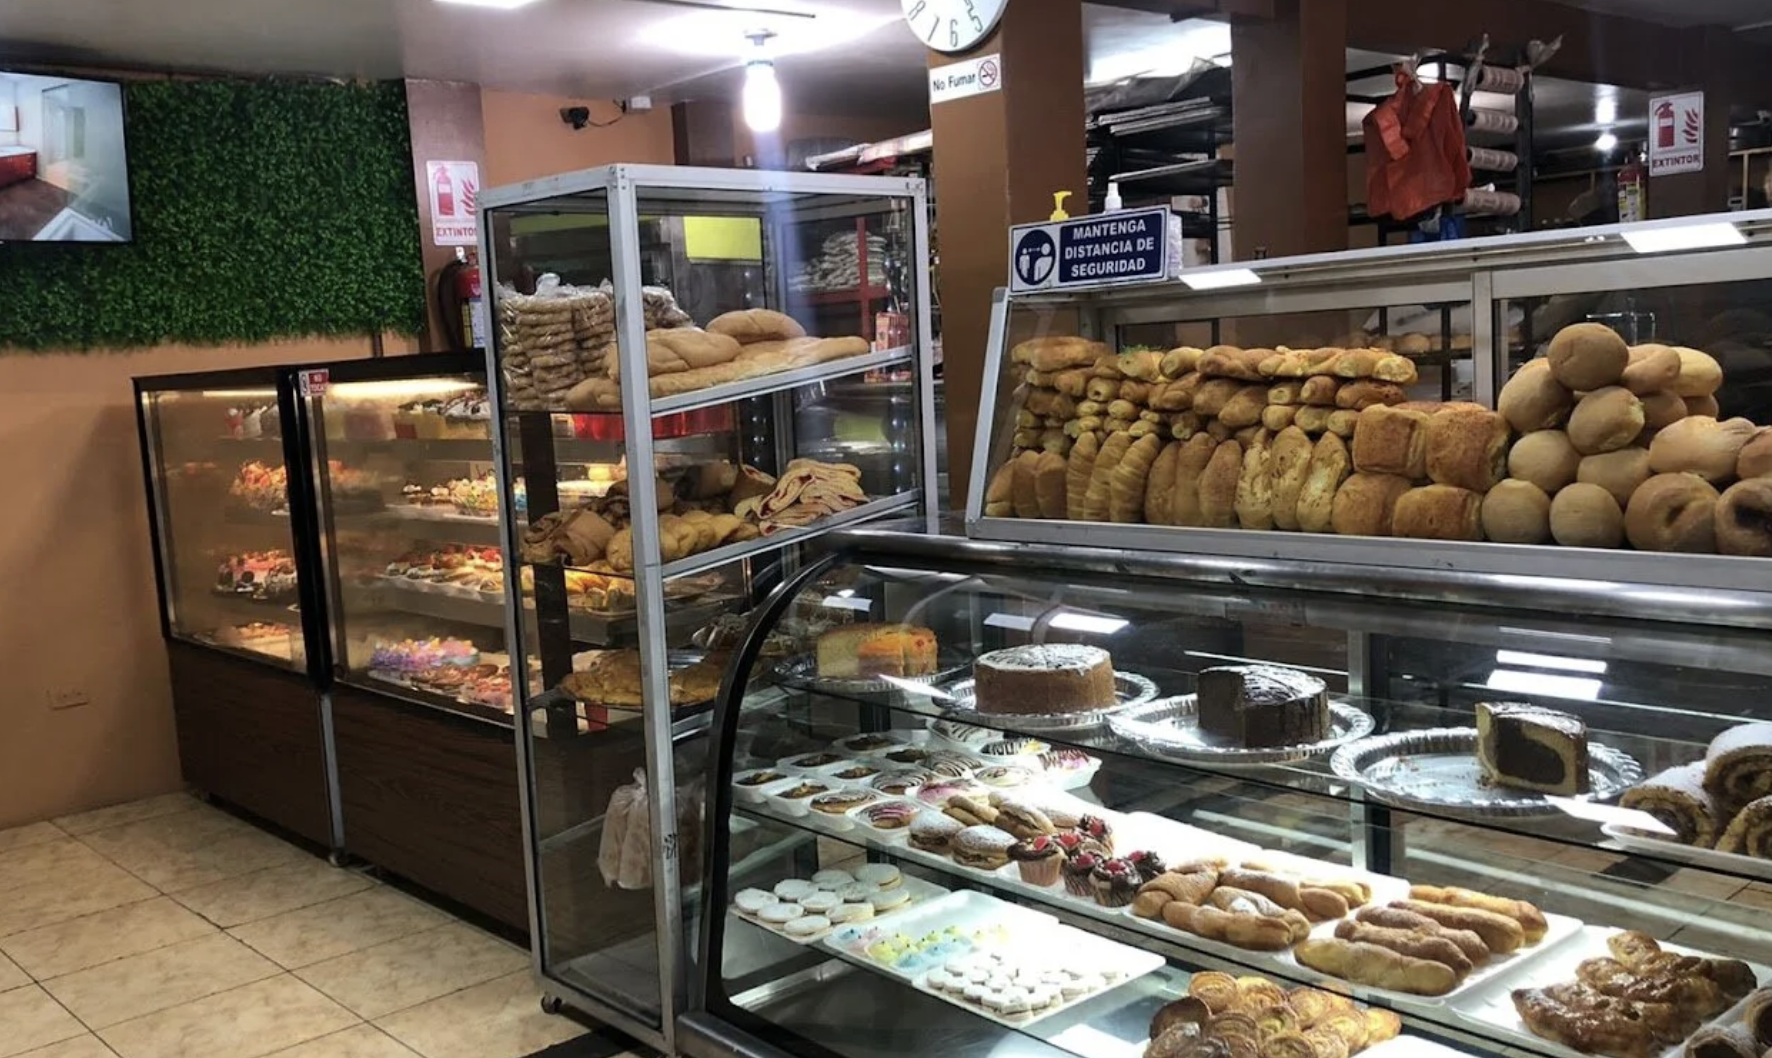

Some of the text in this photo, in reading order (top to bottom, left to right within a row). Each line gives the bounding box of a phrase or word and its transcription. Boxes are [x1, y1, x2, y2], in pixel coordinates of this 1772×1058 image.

[950, 19, 958, 47] 6
[933, 73, 976, 91] No Fumar
[1652, 154, 1700, 168] EXTINTOR
[1073, 219, 1146, 240] MANTENGA
[1064, 237, 1155, 260] DISTANCIA DE
[1070, 257, 1146, 278] SEGURIDAD
